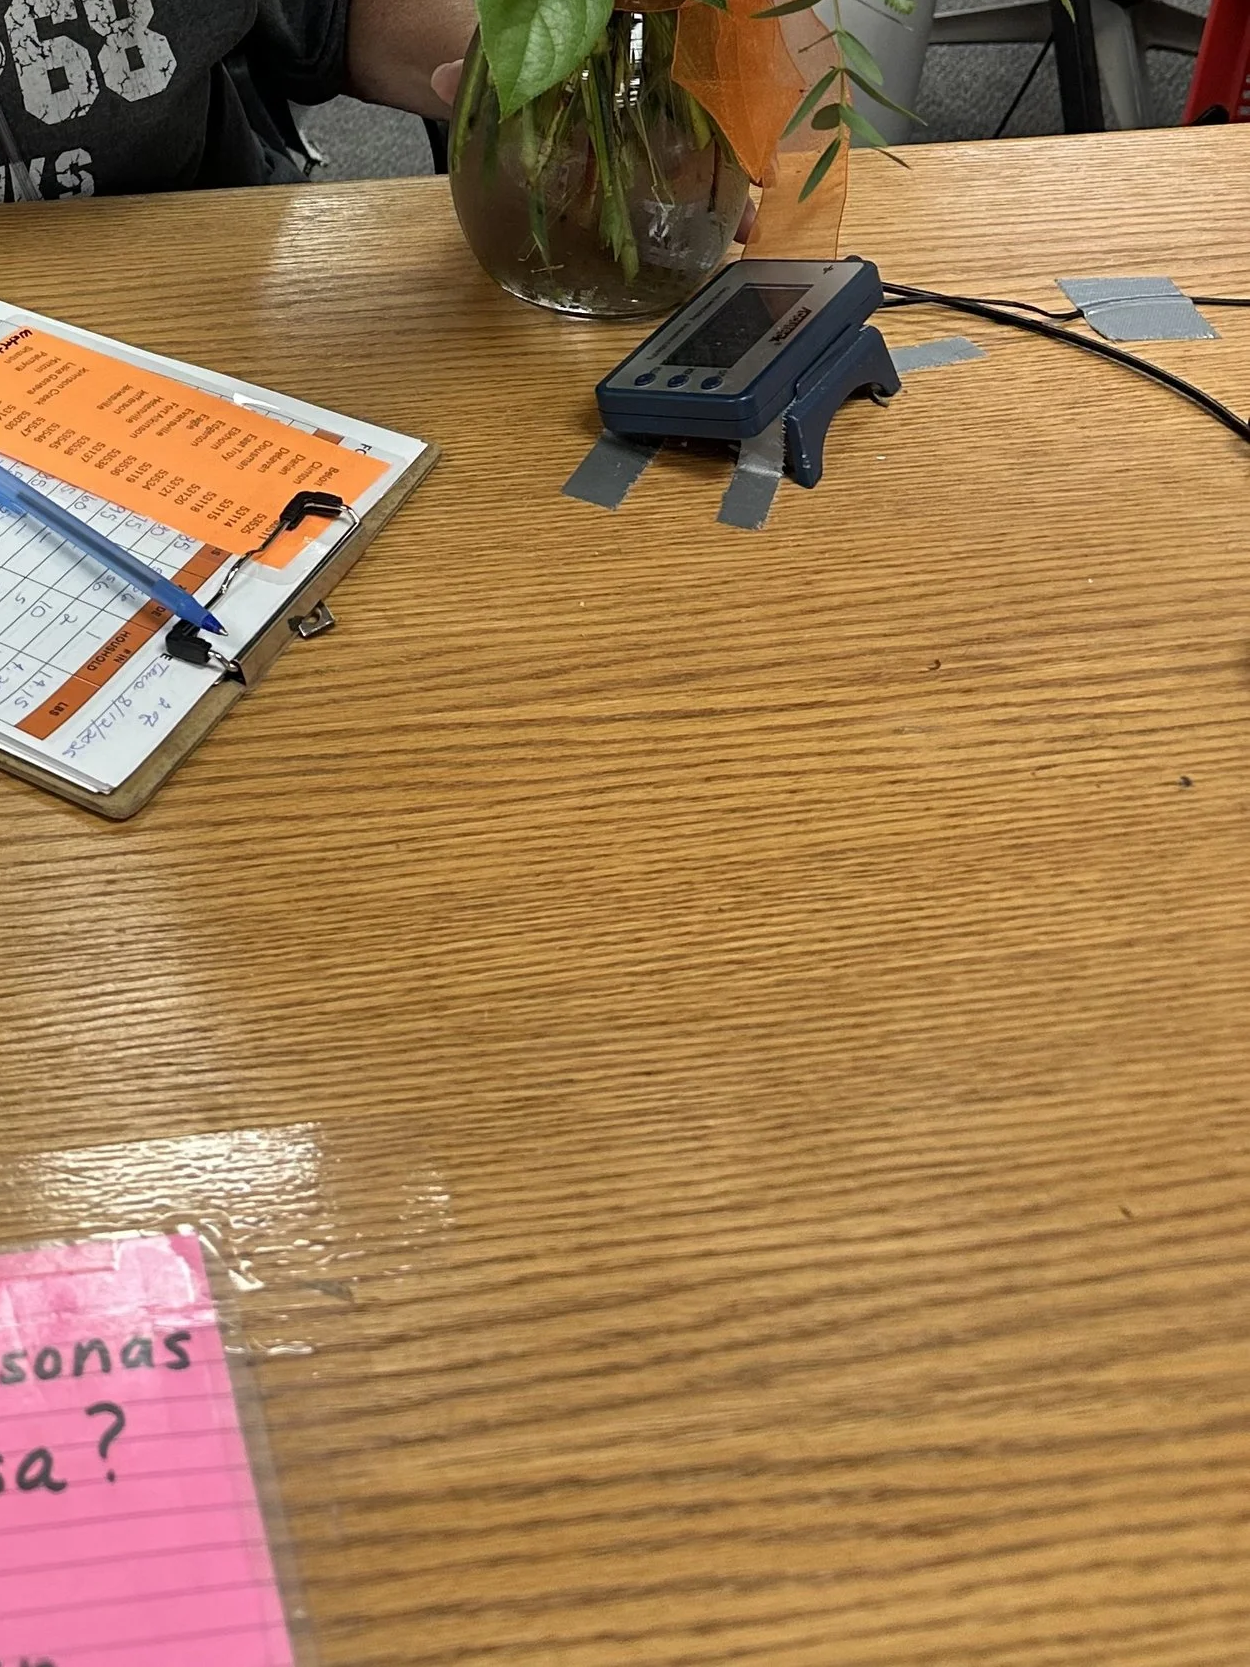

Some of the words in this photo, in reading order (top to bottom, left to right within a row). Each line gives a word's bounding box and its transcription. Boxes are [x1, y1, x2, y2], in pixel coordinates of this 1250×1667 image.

[204, 498, 235, 520] 53115
[220, 505, 251, 527] 53114
[82, 630, 134, 671] HOUSHOLD
[47, 701, 68, 716] LBS
